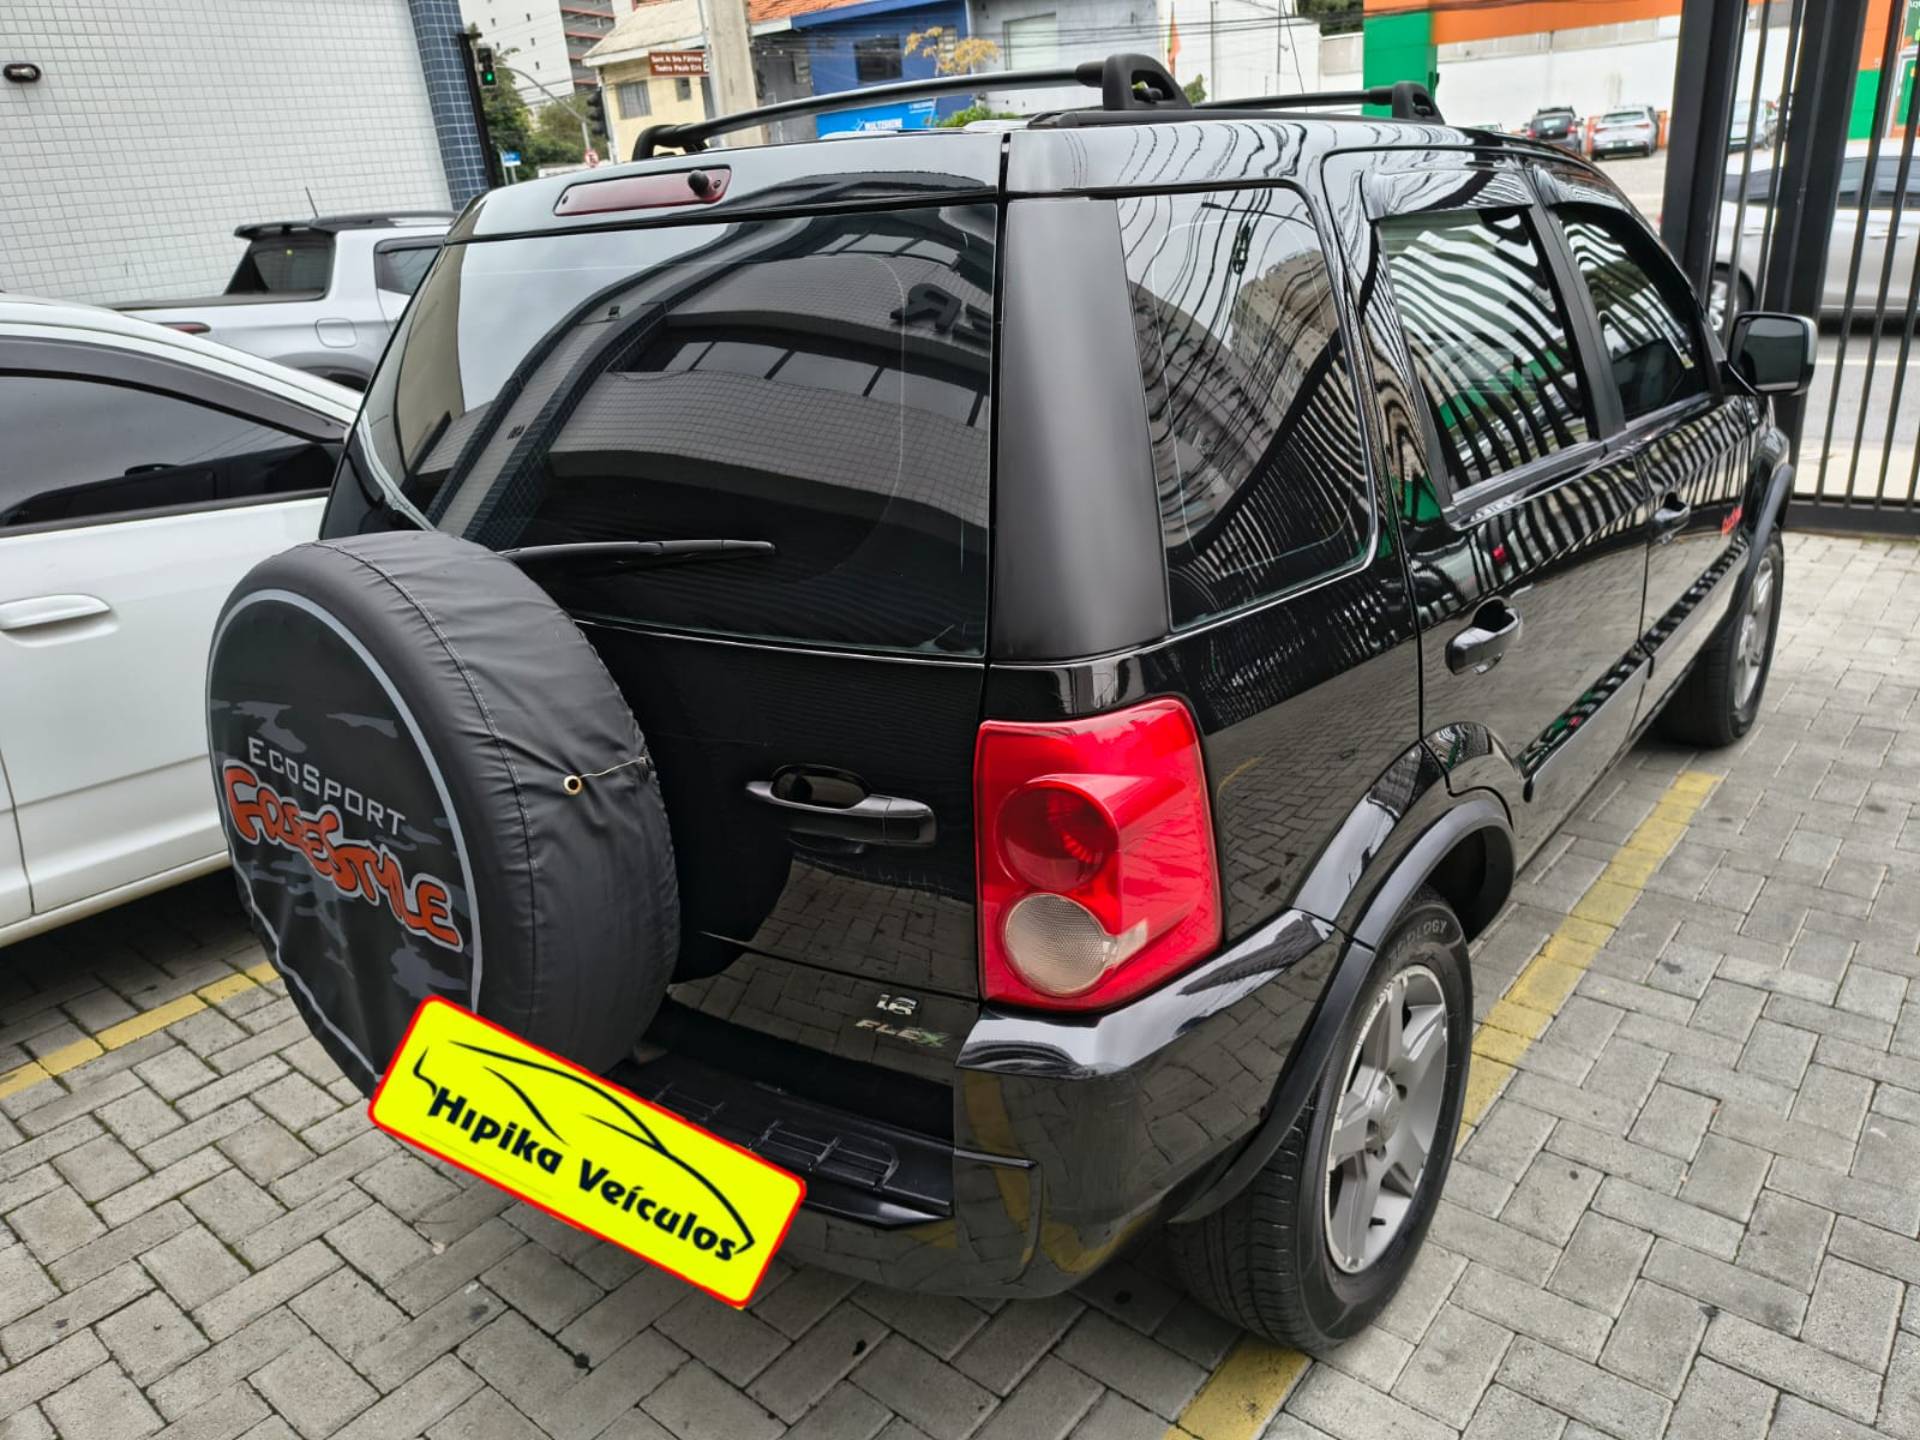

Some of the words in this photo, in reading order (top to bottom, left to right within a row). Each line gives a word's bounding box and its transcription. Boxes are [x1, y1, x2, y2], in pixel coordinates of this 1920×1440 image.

[223, 759, 463, 953] FREESTYLE
[877, 993, 918, 1015] 1.6
[856, 1019, 951, 1048] FLEX
